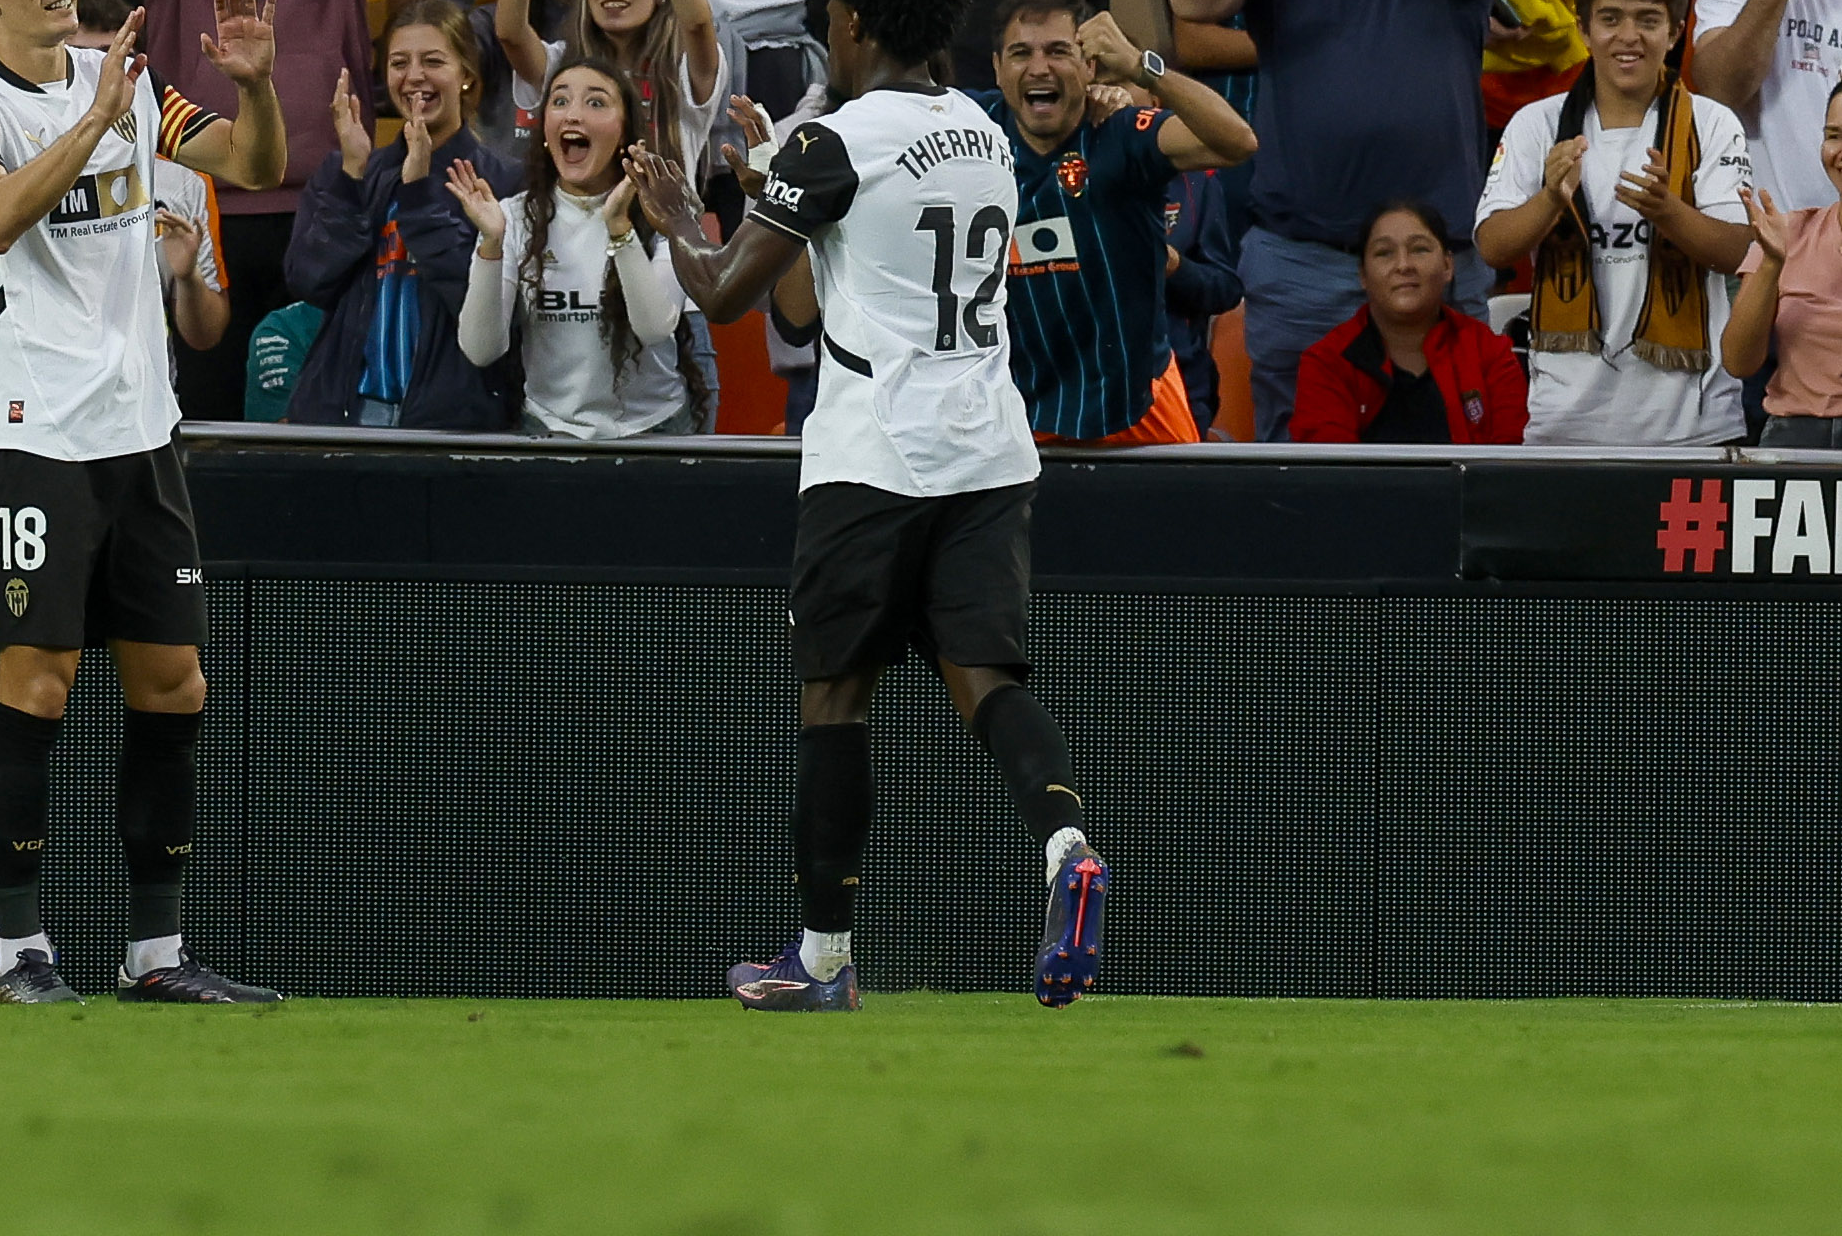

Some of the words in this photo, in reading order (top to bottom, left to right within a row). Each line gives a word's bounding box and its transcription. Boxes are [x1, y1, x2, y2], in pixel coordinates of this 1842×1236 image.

[1786, 19, 1824, 43] POLO
[895, 128, 994, 182] THIERRY
[49, 227, 67, 239] TM
[70, 224, 92, 237] Real
[93, 220, 118, 234] Estate
[914, 205, 1009, 352] 12
[1656, 478, 1842, 575] #FA
